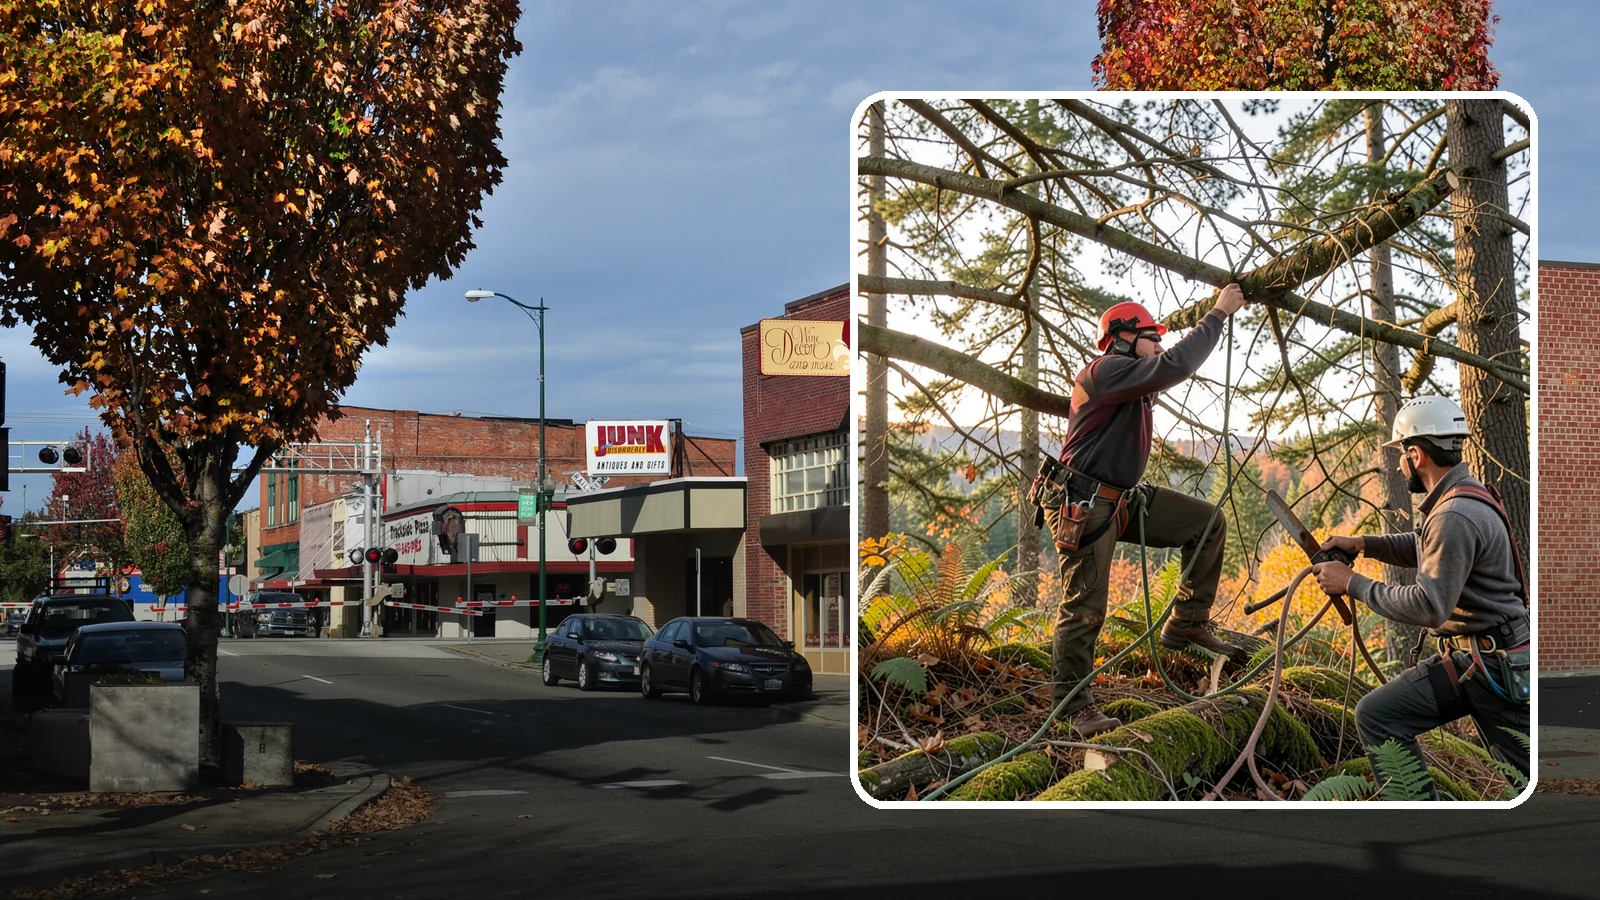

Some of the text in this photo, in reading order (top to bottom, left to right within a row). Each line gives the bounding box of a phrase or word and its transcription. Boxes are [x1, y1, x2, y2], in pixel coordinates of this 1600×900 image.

[765, 327, 831, 365] Decor
[596, 425, 665, 457] JUNK
[608, 446, 645, 454] DISORDERLY
[597, 460, 665, 470] ANTIQUES AND GIFTS
[390, 520, 429, 539] Trackside Pizza
